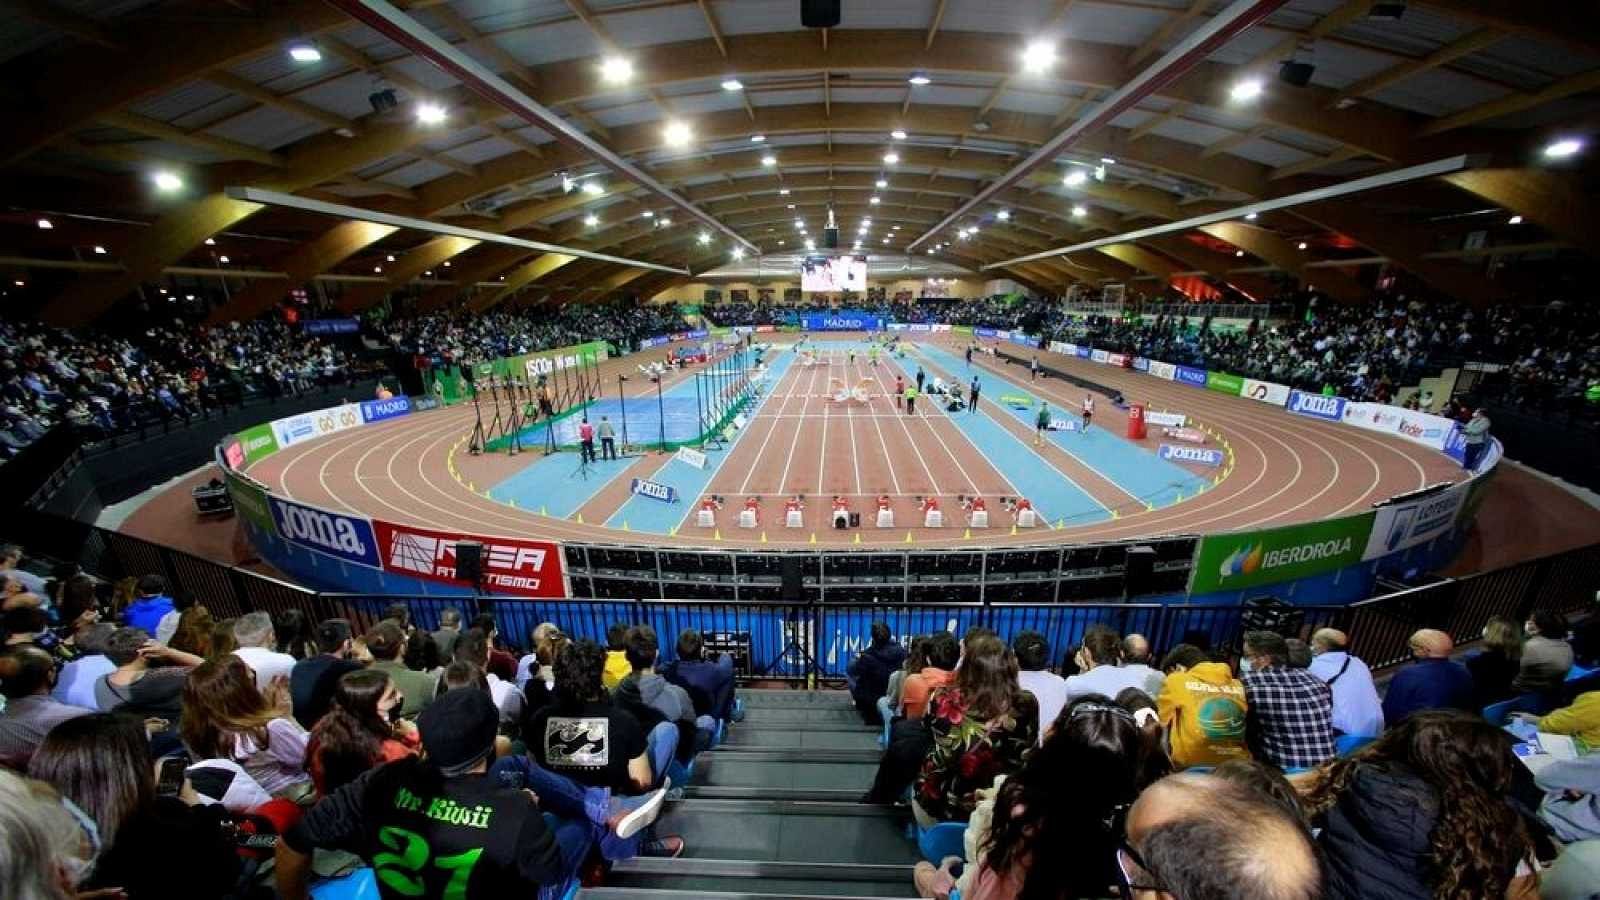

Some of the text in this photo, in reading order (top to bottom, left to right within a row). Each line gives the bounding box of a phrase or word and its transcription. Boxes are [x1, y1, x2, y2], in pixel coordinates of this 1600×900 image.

[280, 502, 366, 556] Joma
[437, 539, 547, 573] REA
[1262, 537, 1352, 569] IBERDROLA
[436, 566, 540, 590] ATTISMO
